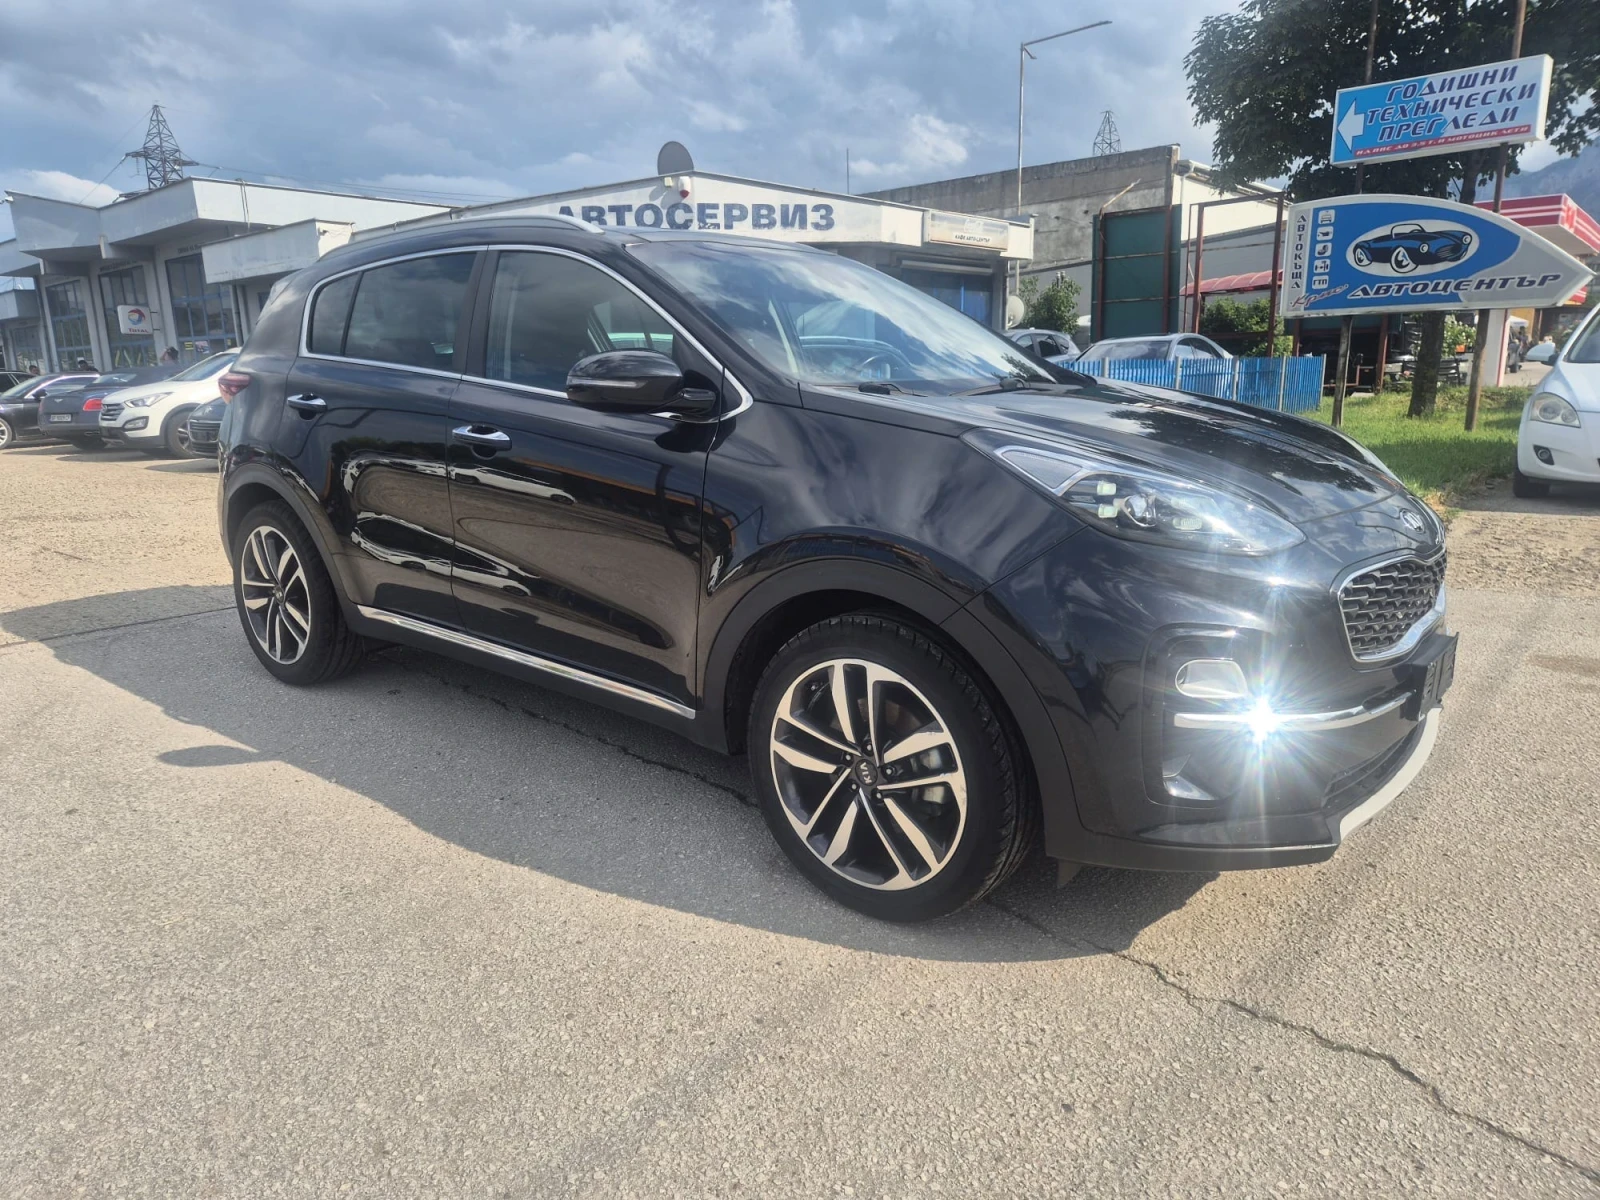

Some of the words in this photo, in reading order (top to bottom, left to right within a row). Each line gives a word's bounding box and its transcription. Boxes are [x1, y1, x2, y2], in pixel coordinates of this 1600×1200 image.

[1386, 65, 1518, 102] ГОДИШНИ
[1367, 83, 1537, 124] ТЕХНИЧЕСКИ
[1377, 106, 1519, 142] ПРЕГЛЕДИ
[1291, 215, 1307, 289] АВТОКЪЩА
[1349, 274, 1562, 298] АВТОЦЕНТЪР
[860, 762, 873, 784] KIA
